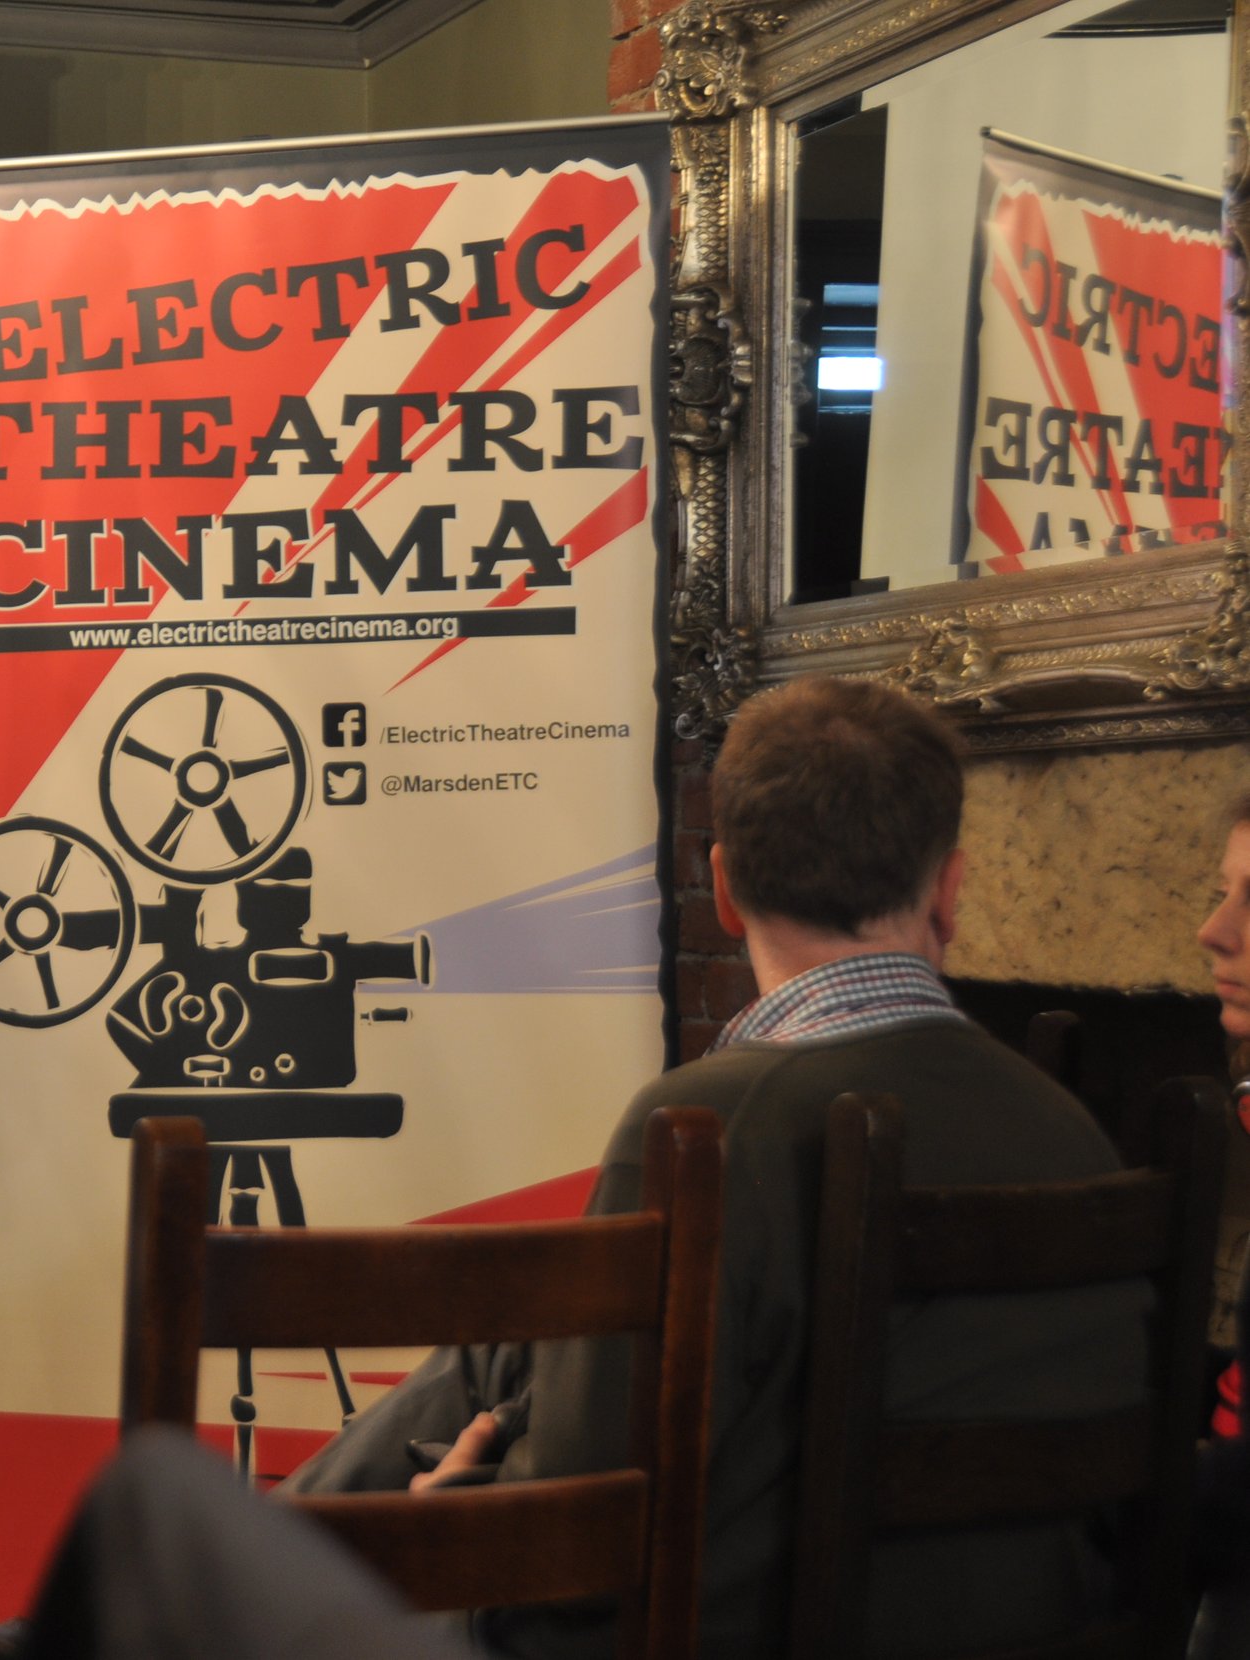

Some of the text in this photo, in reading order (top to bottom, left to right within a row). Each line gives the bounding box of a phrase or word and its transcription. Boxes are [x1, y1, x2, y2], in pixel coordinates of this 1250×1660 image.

[69, 613, 459, 649] www.electrictheatrecinema.org
[379, 722, 630, 745] /ElectricTheatreCinema
[380, 772, 538, 796] @MarsdenETC
